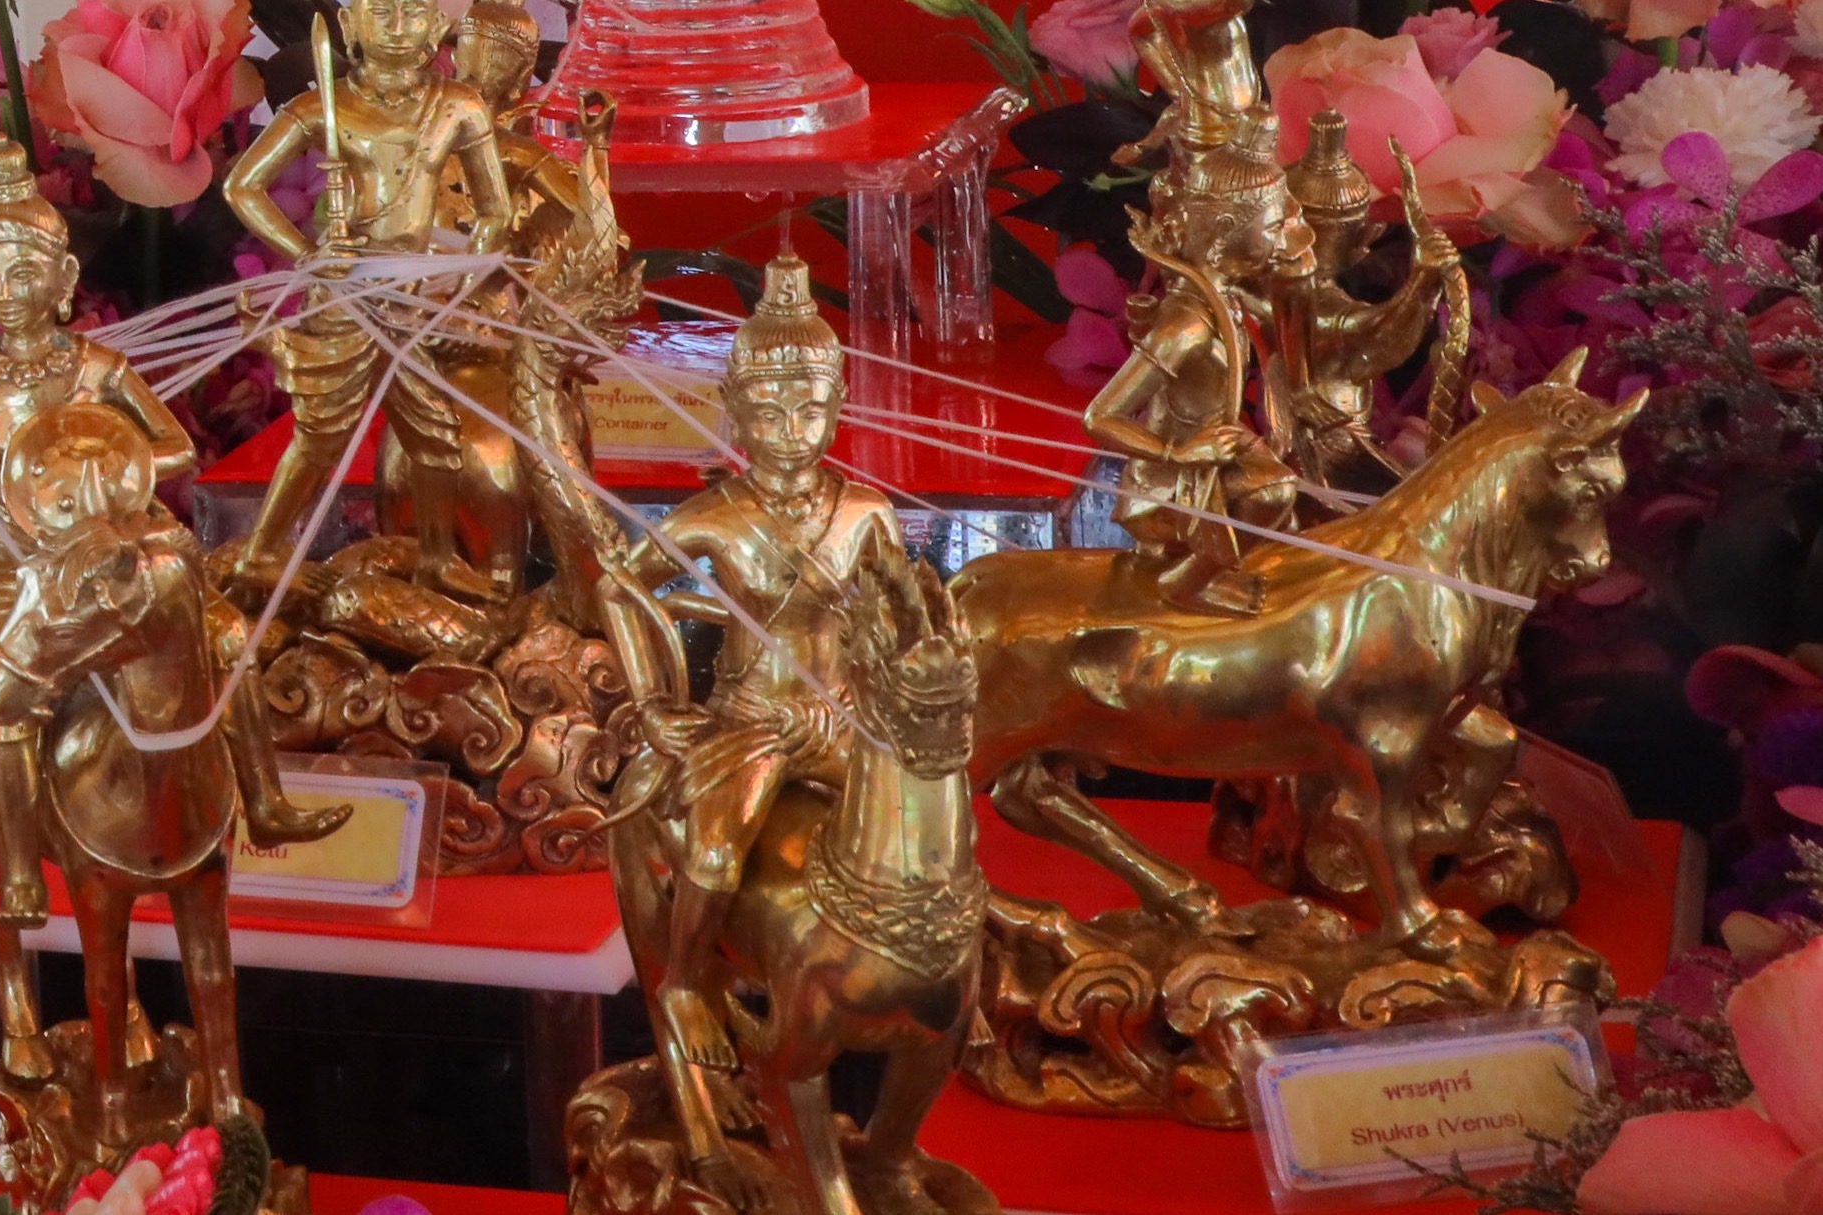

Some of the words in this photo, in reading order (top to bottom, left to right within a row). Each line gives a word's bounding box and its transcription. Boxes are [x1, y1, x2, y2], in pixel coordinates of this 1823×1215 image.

[595, 416, 668, 430] Container
[1382, 1068, 1473, 1104] พระศุกร์
[1351, 1124, 1429, 1147] Shukra
[1437, 1110, 1525, 1139] (Venus)
